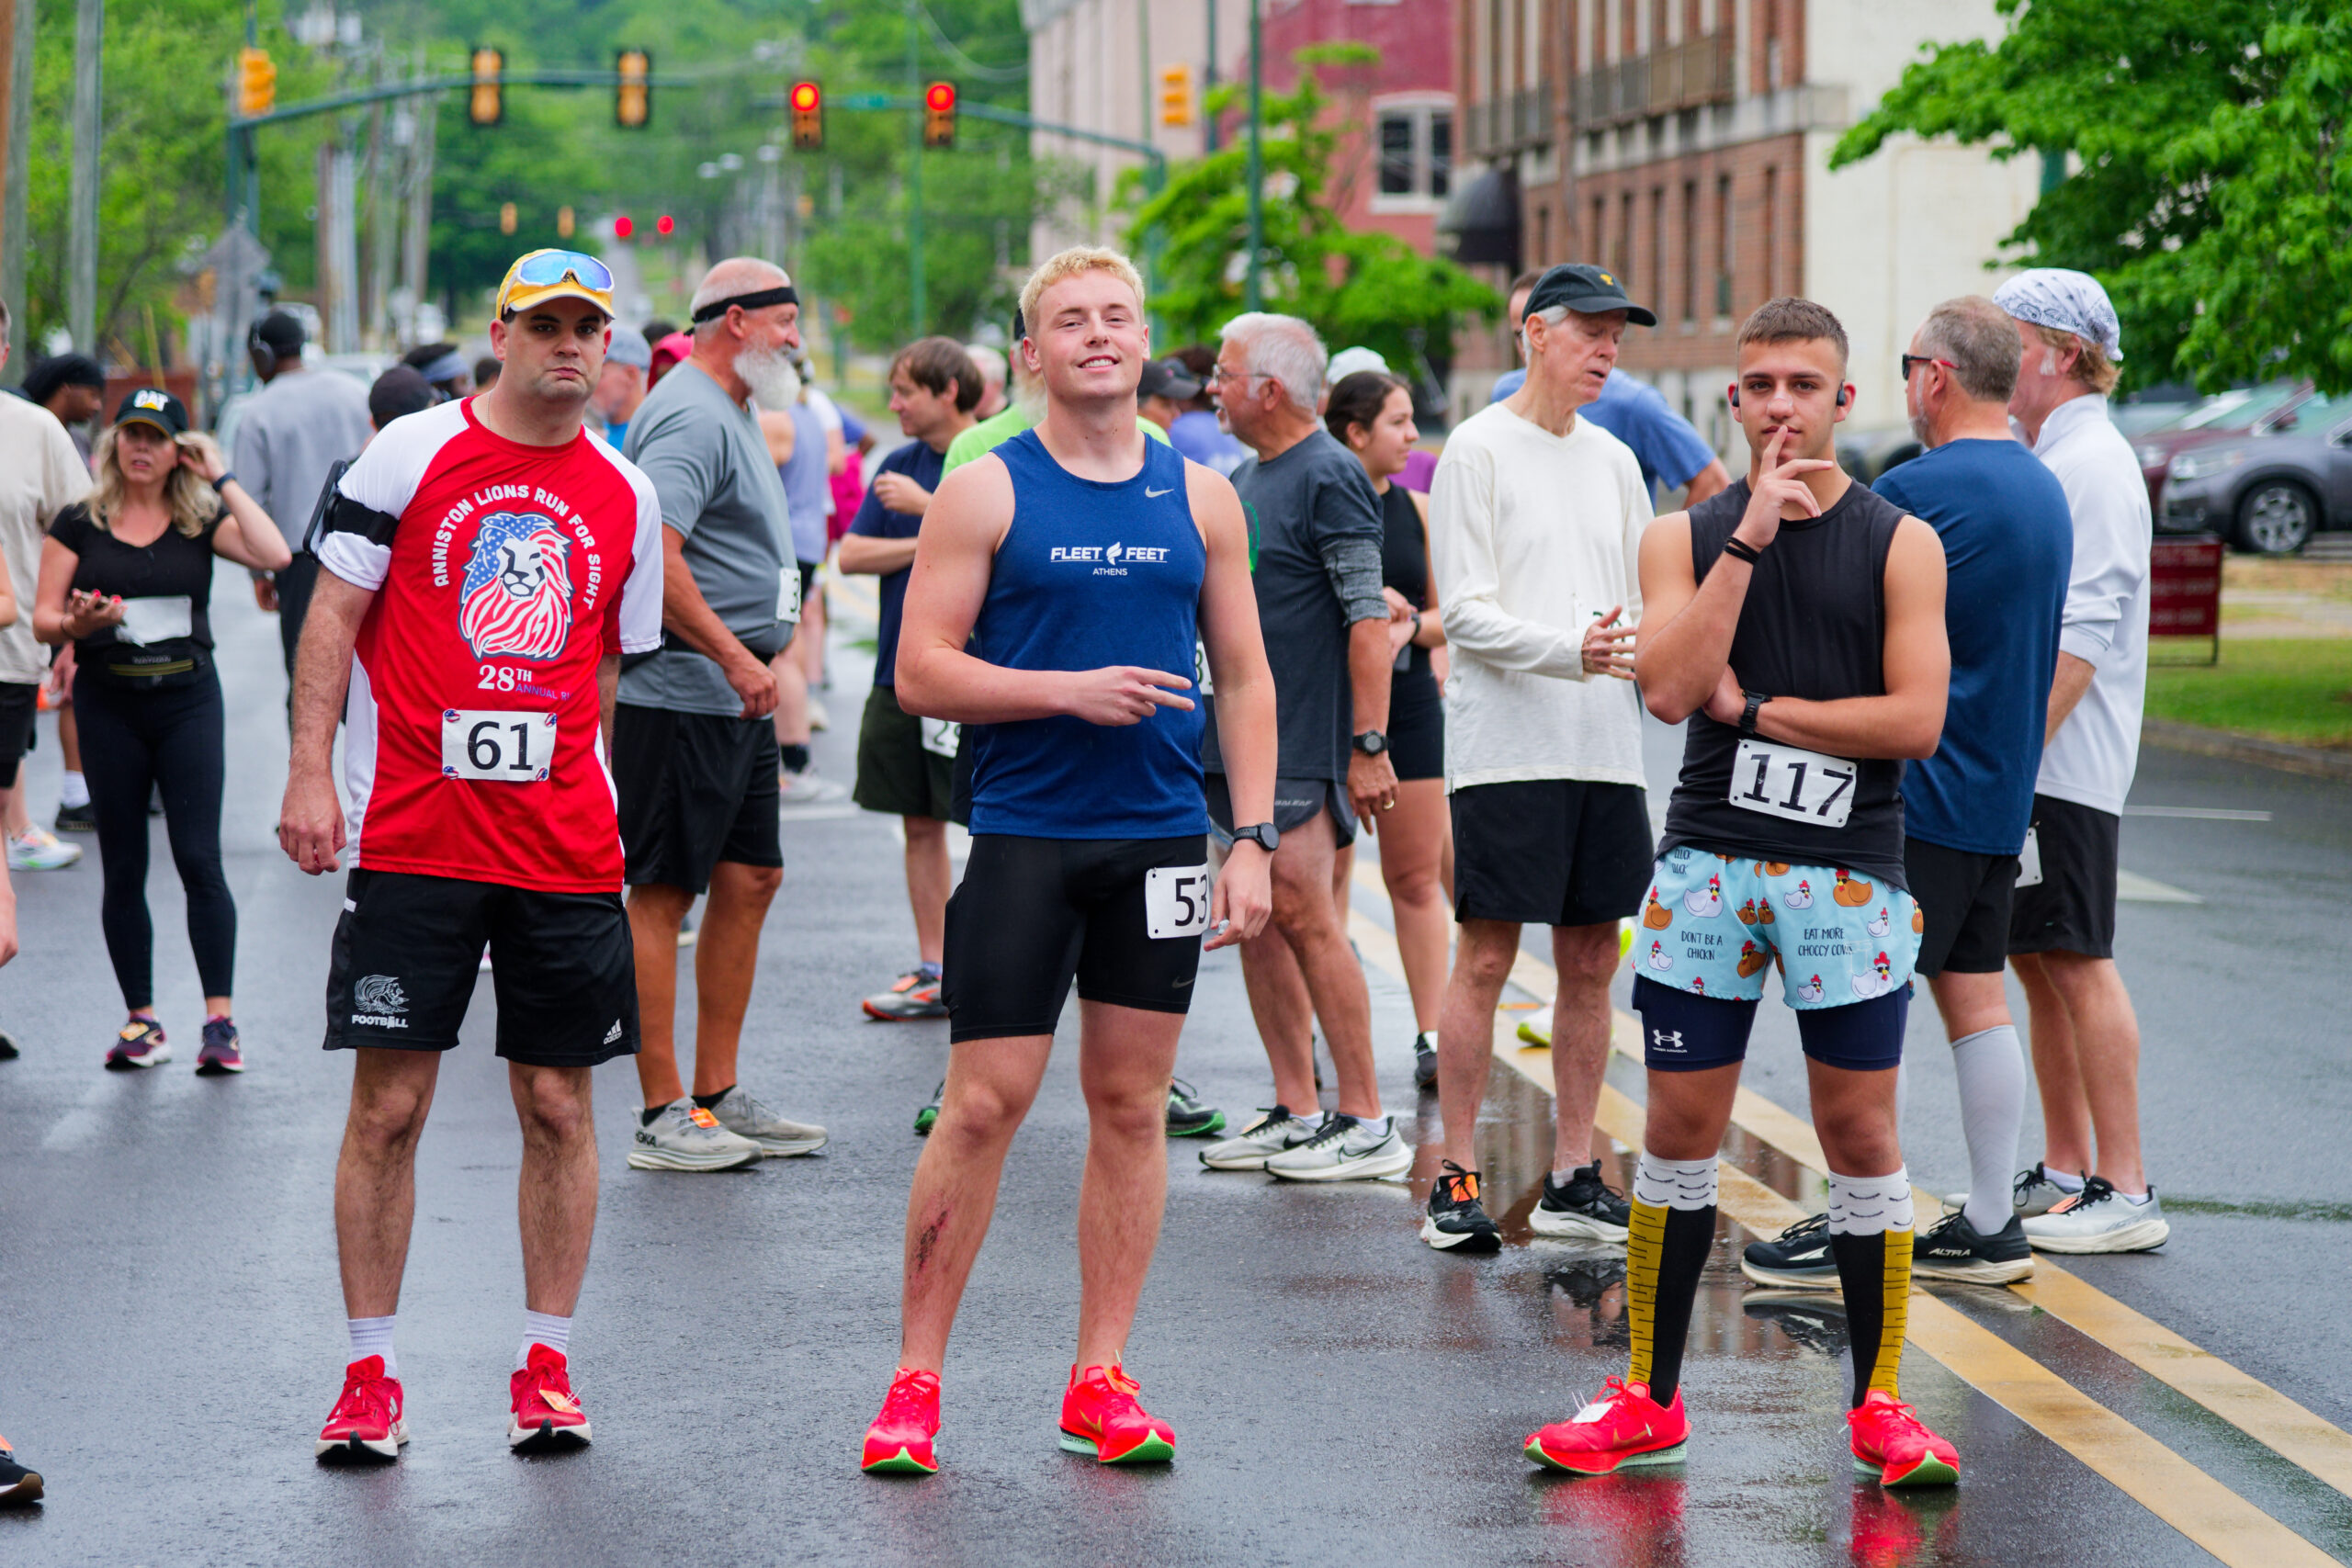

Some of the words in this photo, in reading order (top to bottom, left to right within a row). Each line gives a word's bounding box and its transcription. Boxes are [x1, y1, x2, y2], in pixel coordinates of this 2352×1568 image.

[133, 389, 169, 412] CAT
[432, 498, 475, 588] ANNISTON
[473, 484, 530, 506] LIONS
[533, 486, 570, 517] RUN
[567, 513, 596, 550] FOR
[582, 553, 602, 611] SIGHT
[1050, 547, 1103, 560] FLEET
[1125, 547, 1168, 561] FEET
[1092, 567, 1128, 577] ATHENS
[514, 682, 559, 701] ANNUAL
[467, 720, 534, 771] 61
[1742, 753, 1854, 818] 117
[1174, 874, 1208, 927] 53
[1704, 933, 1715, 945] BE
[1716, 935, 1724, 946] A
[1804, 928, 1819, 941] EAT
[1821, 927, 1845, 940] MORE
[1798, 944, 1830, 957] CHOCCY
[351, 1014, 410, 1029] FOOTBALL
[1928, 1247, 1972, 1257] ALTRA
